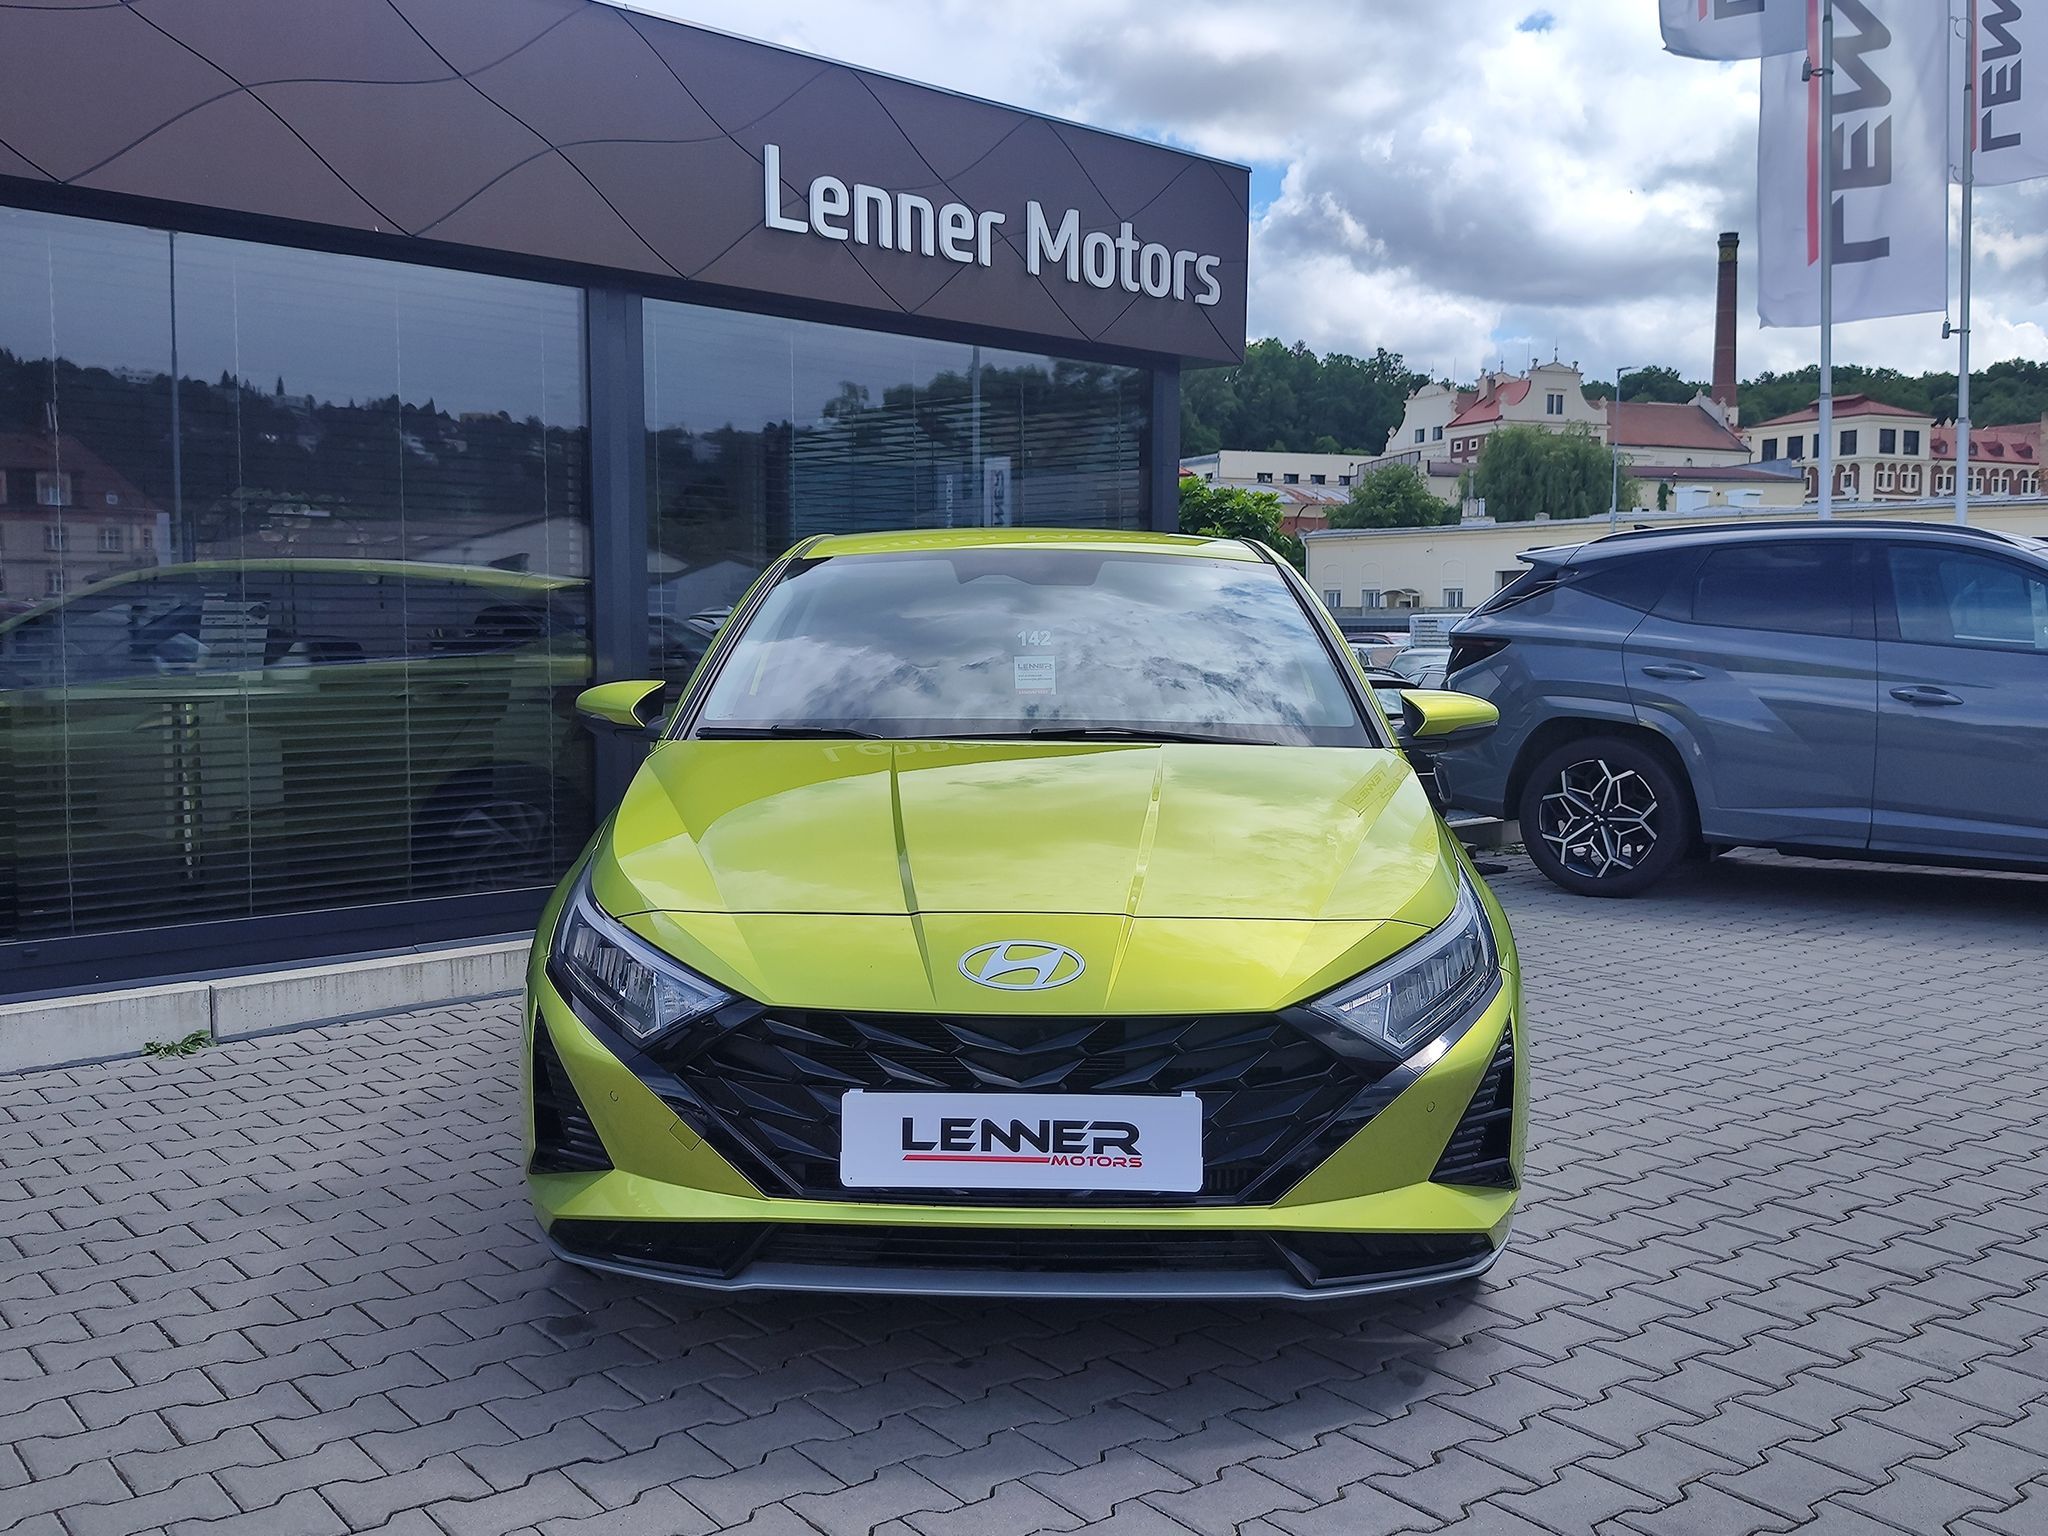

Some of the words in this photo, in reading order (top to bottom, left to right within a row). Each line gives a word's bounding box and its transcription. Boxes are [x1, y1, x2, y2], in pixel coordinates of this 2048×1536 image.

[764, 143, 1006, 268] Lenner
[1026, 200, 1222, 306] Motors
[1017, 630, 1052, 647] 142
[901, 1117, 1143, 1155] LENNER
[1050, 1156, 1143, 1168] MOTORS
